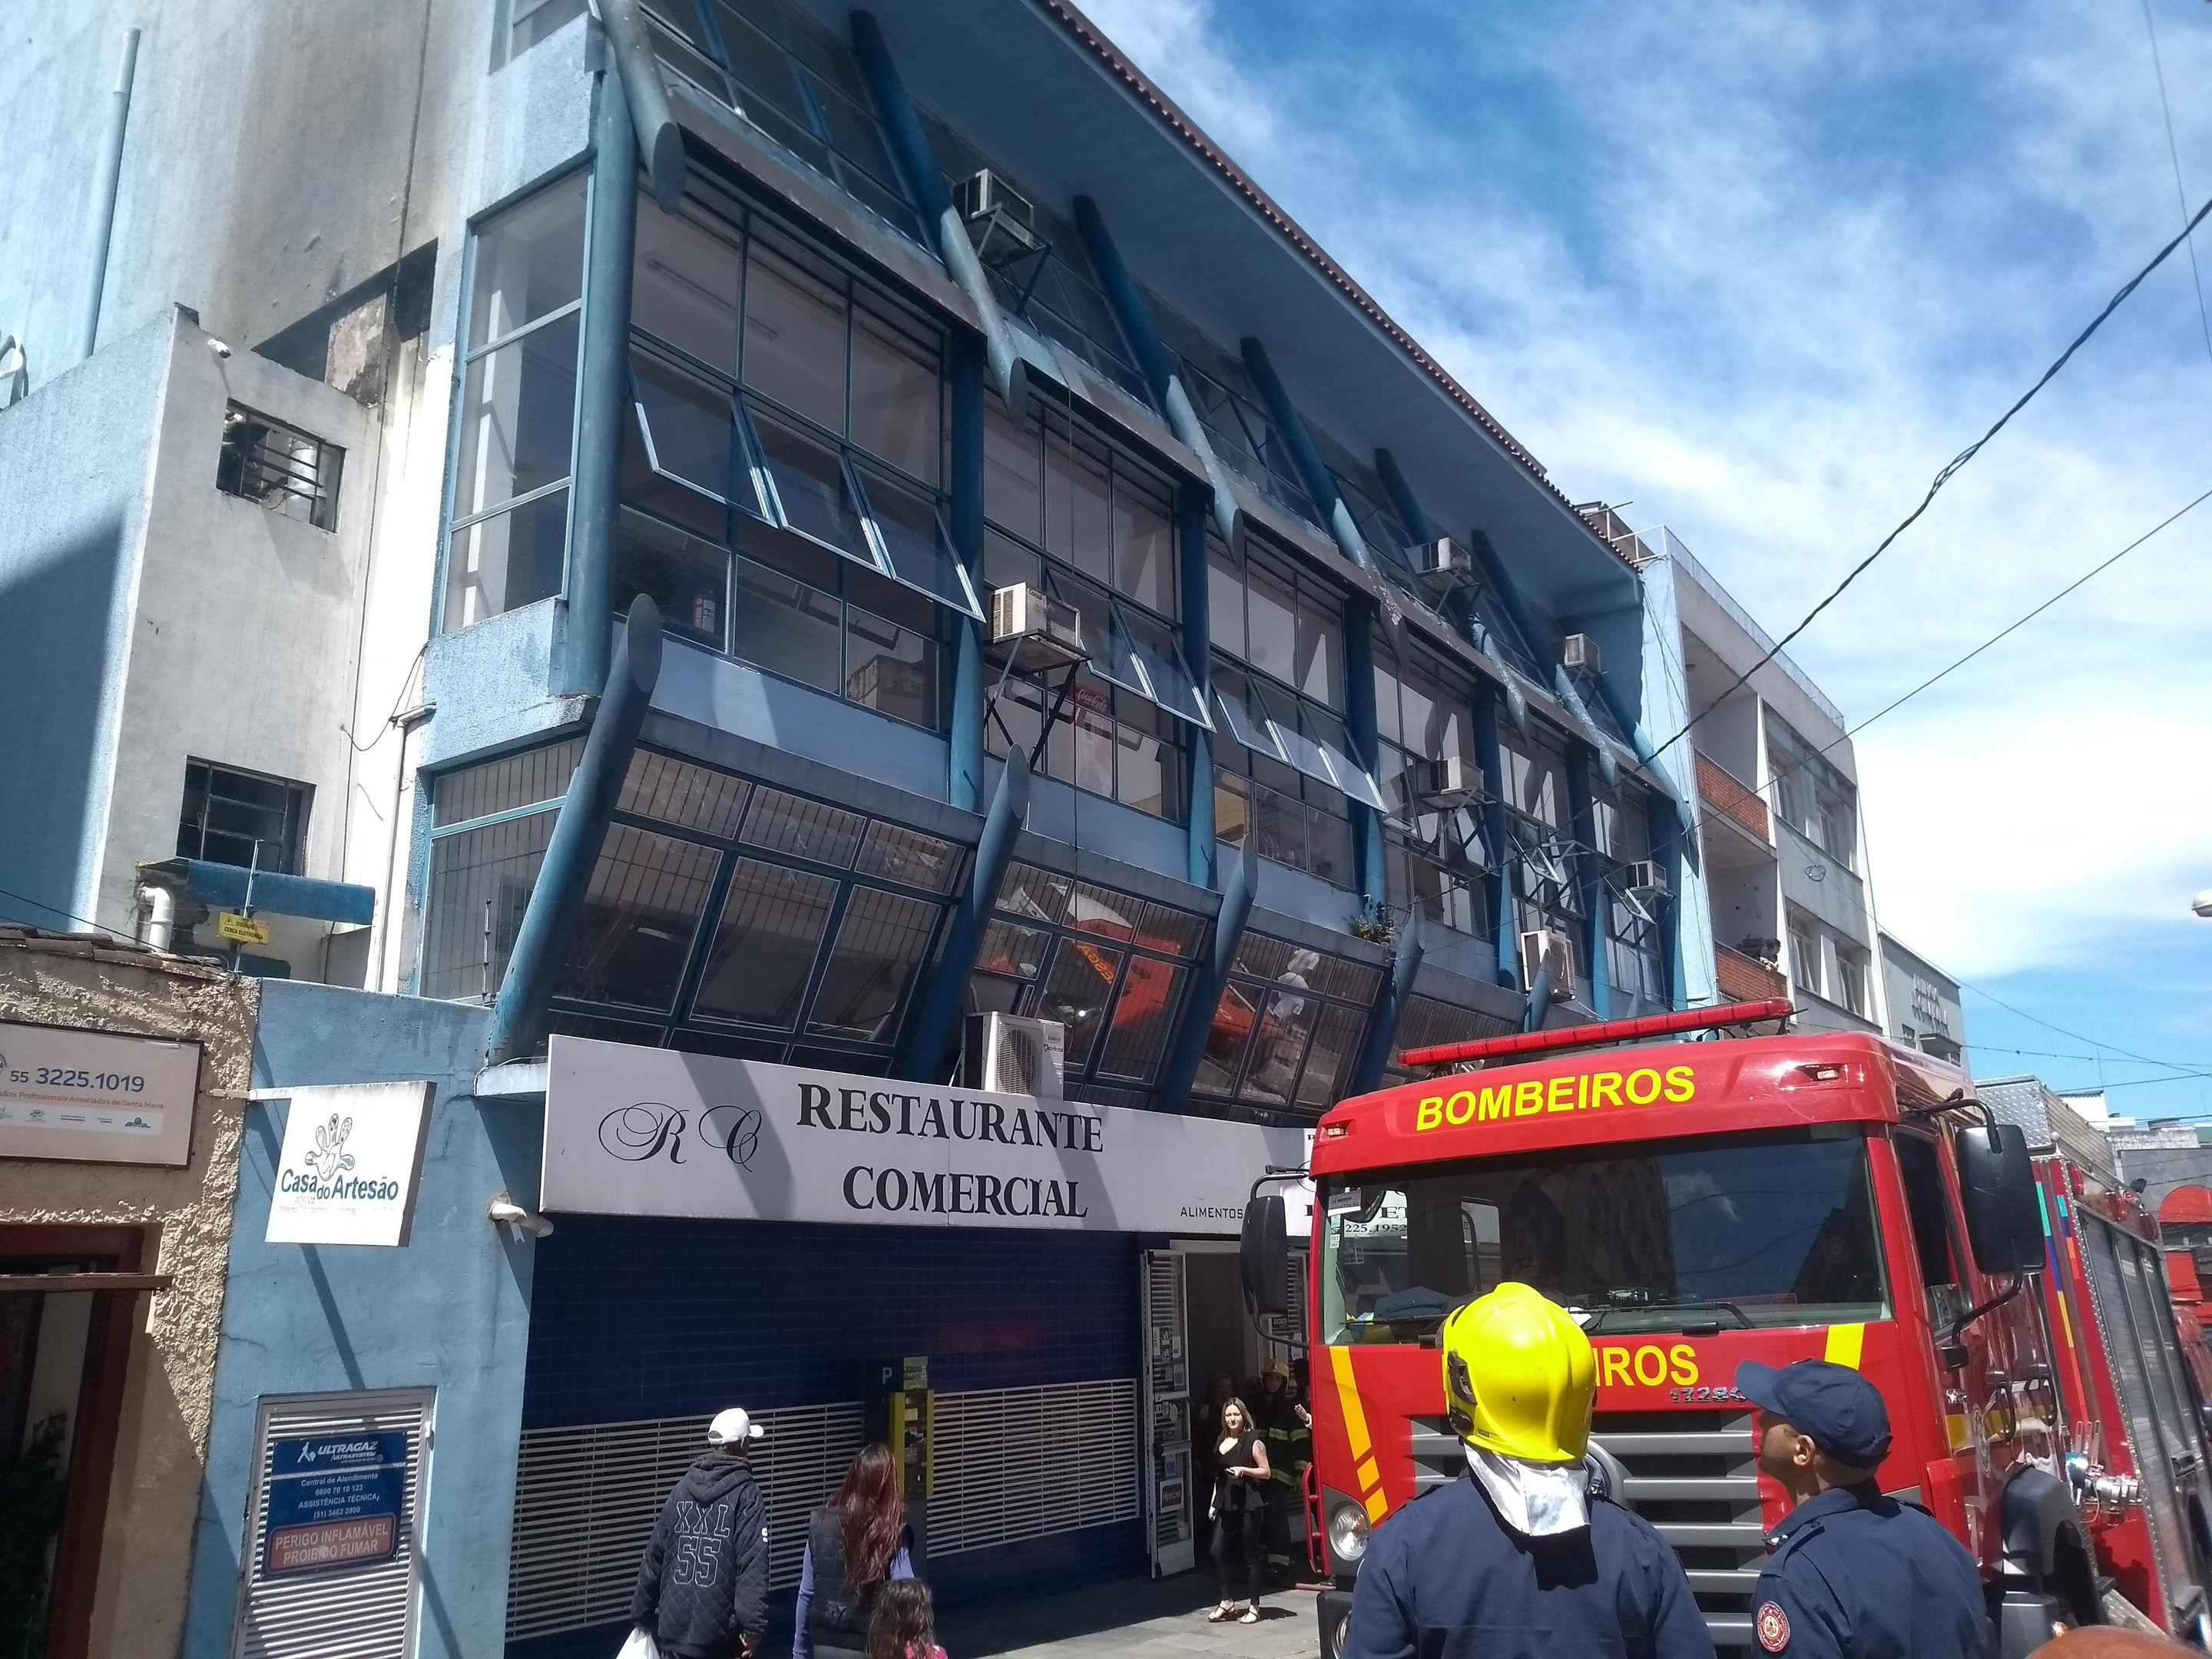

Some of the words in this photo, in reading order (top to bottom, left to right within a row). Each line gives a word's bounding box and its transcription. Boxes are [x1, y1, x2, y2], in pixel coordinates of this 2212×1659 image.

[10, 1070, 29, 1083] 55
[35, 1067, 145, 1093] 3225.1019
[18, 1091, 68, 1101] Profissionais
[69, 1096, 111, 1105] Associados
[1416, 1065, 1695, 1131] BOMBEIROS
[797, 1083, 1104, 1153] RESTAURANTE
[281, 1168, 318, 1193] Casa
[316, 1184, 330, 1200] do
[331, 1174, 399, 1200] Artesão
[843, 1165, 1088, 1218] COMERCIAL
[1181, 1206, 1243, 1219] ALIMENTOS
[1345, 1224, 1407, 1233] 225.1952
[882, 1366, 892, 1383] P
[1591, 1344, 1700, 1387] IROS
[318, 1441, 378, 1455] ULTRAGAZ
[301, 1478, 326, 1487] Central
[336, 1473, 379, 1482] Atendimento
[298, 1496, 346, 1509] ASSISTÊNCIA
[313, 1511, 326, 1520] (51)
[674, 1501, 730, 1538] XXL
[275, 1532, 319, 1549] PERIGO
[321, 1522, 388, 1543] INFLAMÁVEL
[283, 1544, 338, 1565] PROIBIDO
[340, 1540, 378, 1556] FUMAR
[673, 1536, 722, 1588] 55
